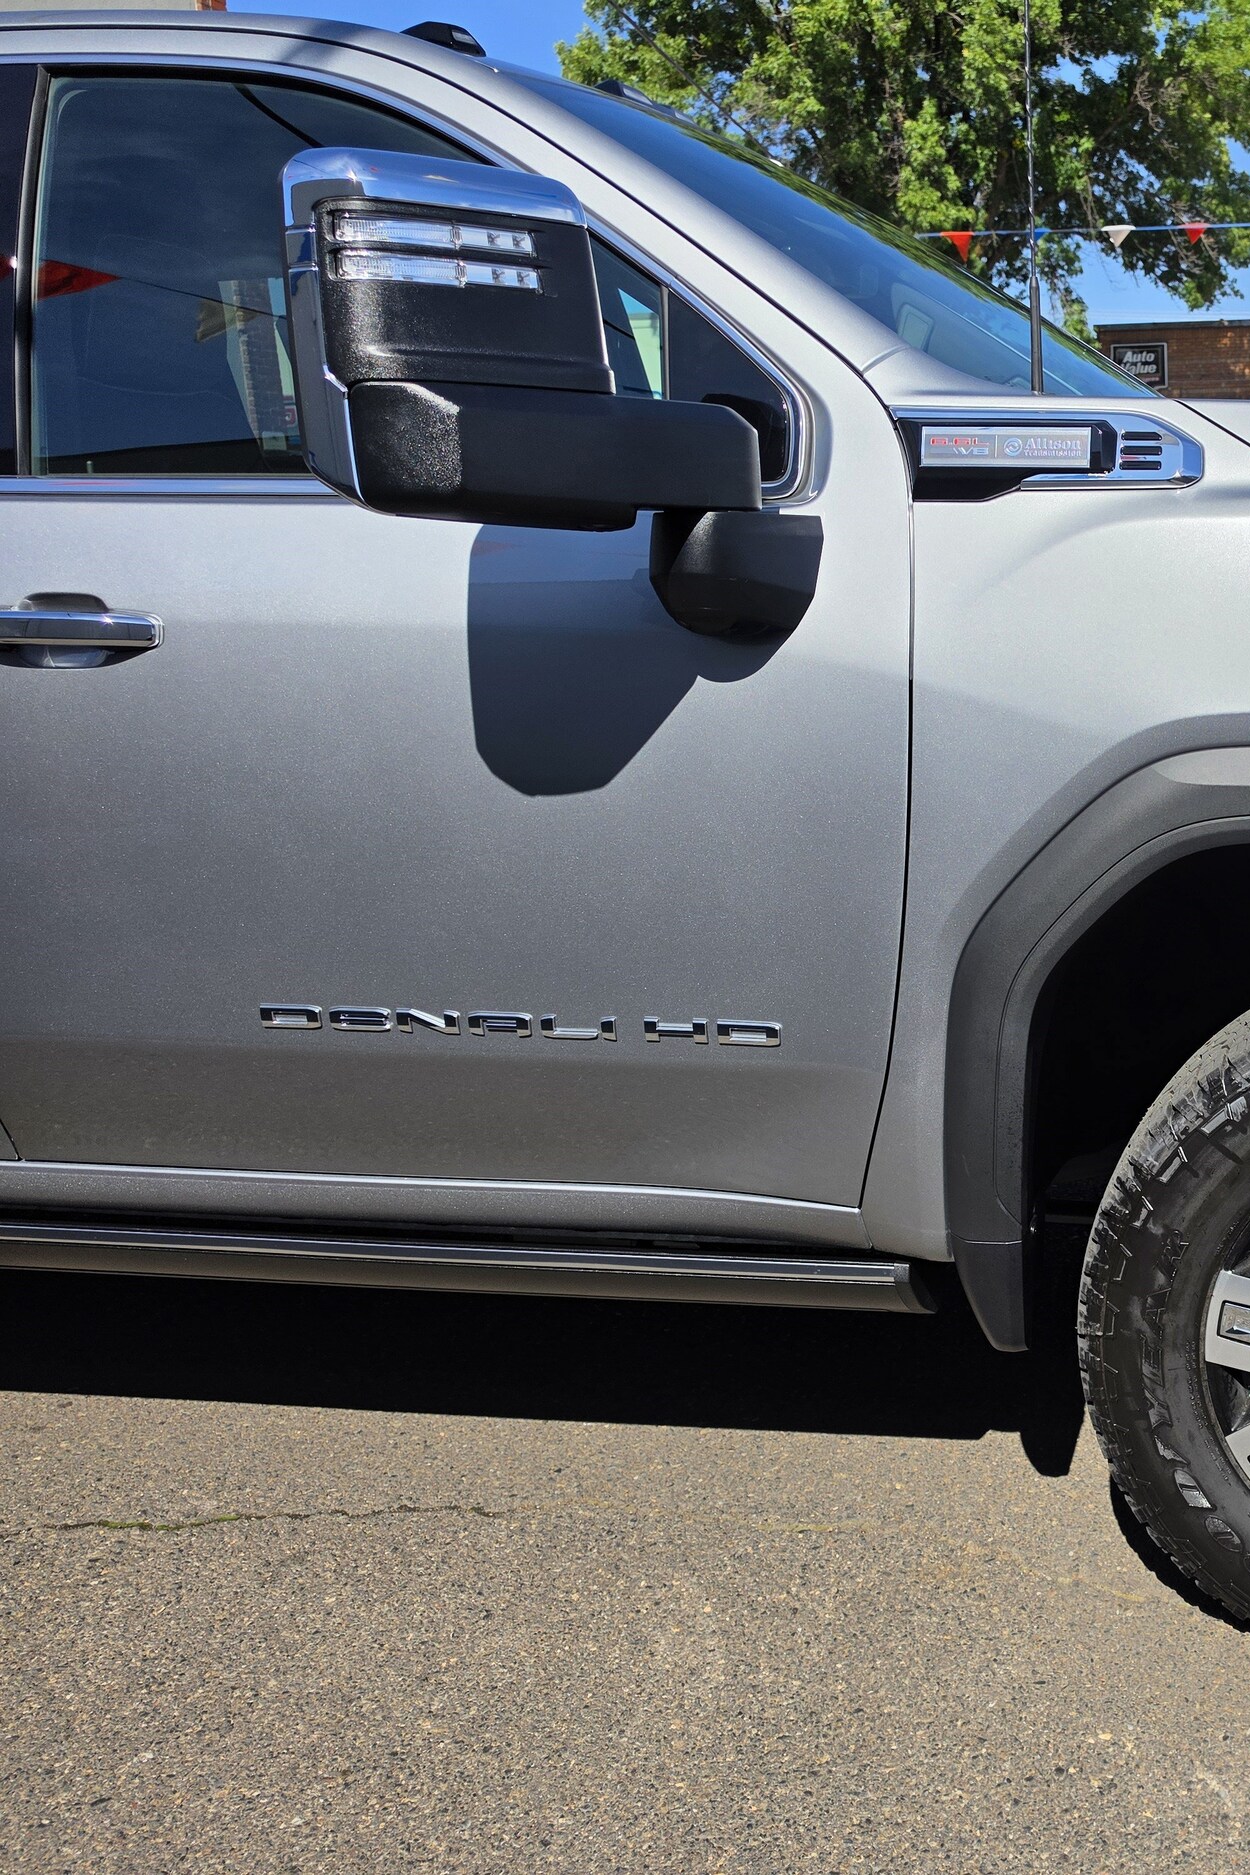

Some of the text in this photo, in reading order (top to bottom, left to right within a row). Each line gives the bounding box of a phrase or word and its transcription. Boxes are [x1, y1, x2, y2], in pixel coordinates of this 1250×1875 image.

[1122, 350, 1155, 363] Auto
[1024, 437, 1081, 450] Allison
[1023, 449, 1082, 457] Transmission
[259, 1002, 783, 1047] DENALI HD
